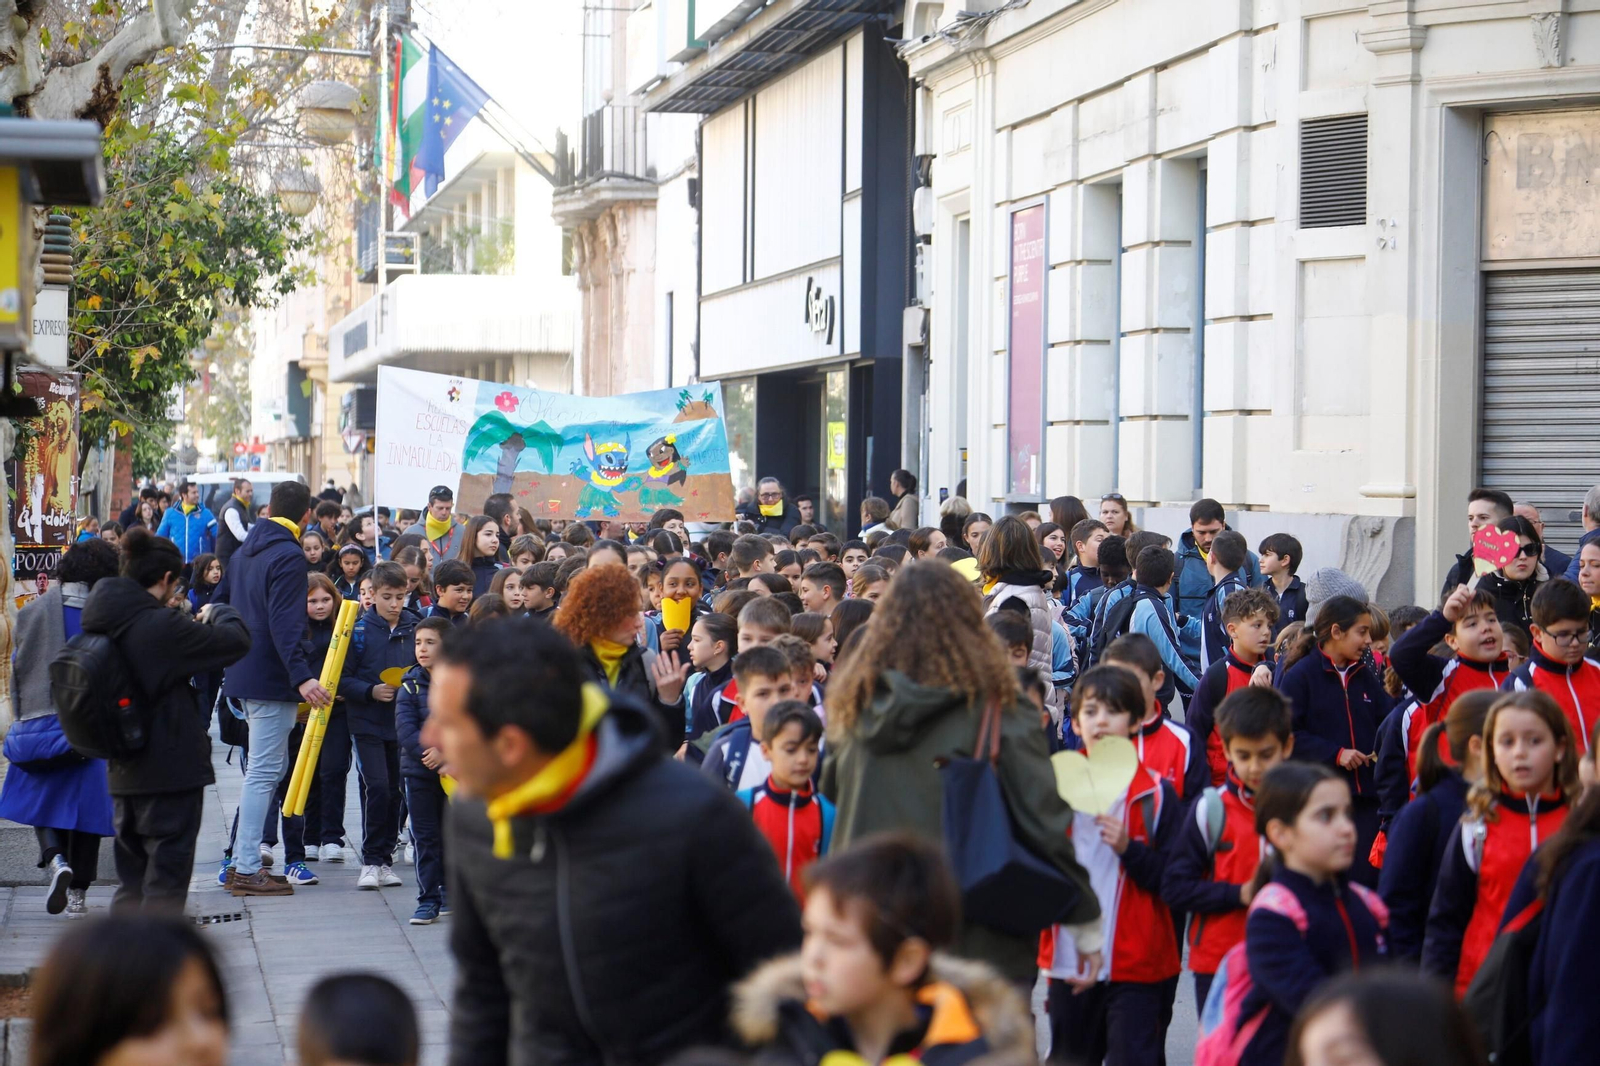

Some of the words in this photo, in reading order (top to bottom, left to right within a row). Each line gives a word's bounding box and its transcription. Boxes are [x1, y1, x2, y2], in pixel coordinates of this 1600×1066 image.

[416, 412, 467, 435] ESCUELAS
[428, 433, 443, 447] LA
[386, 442, 459, 473] INMACULADA
